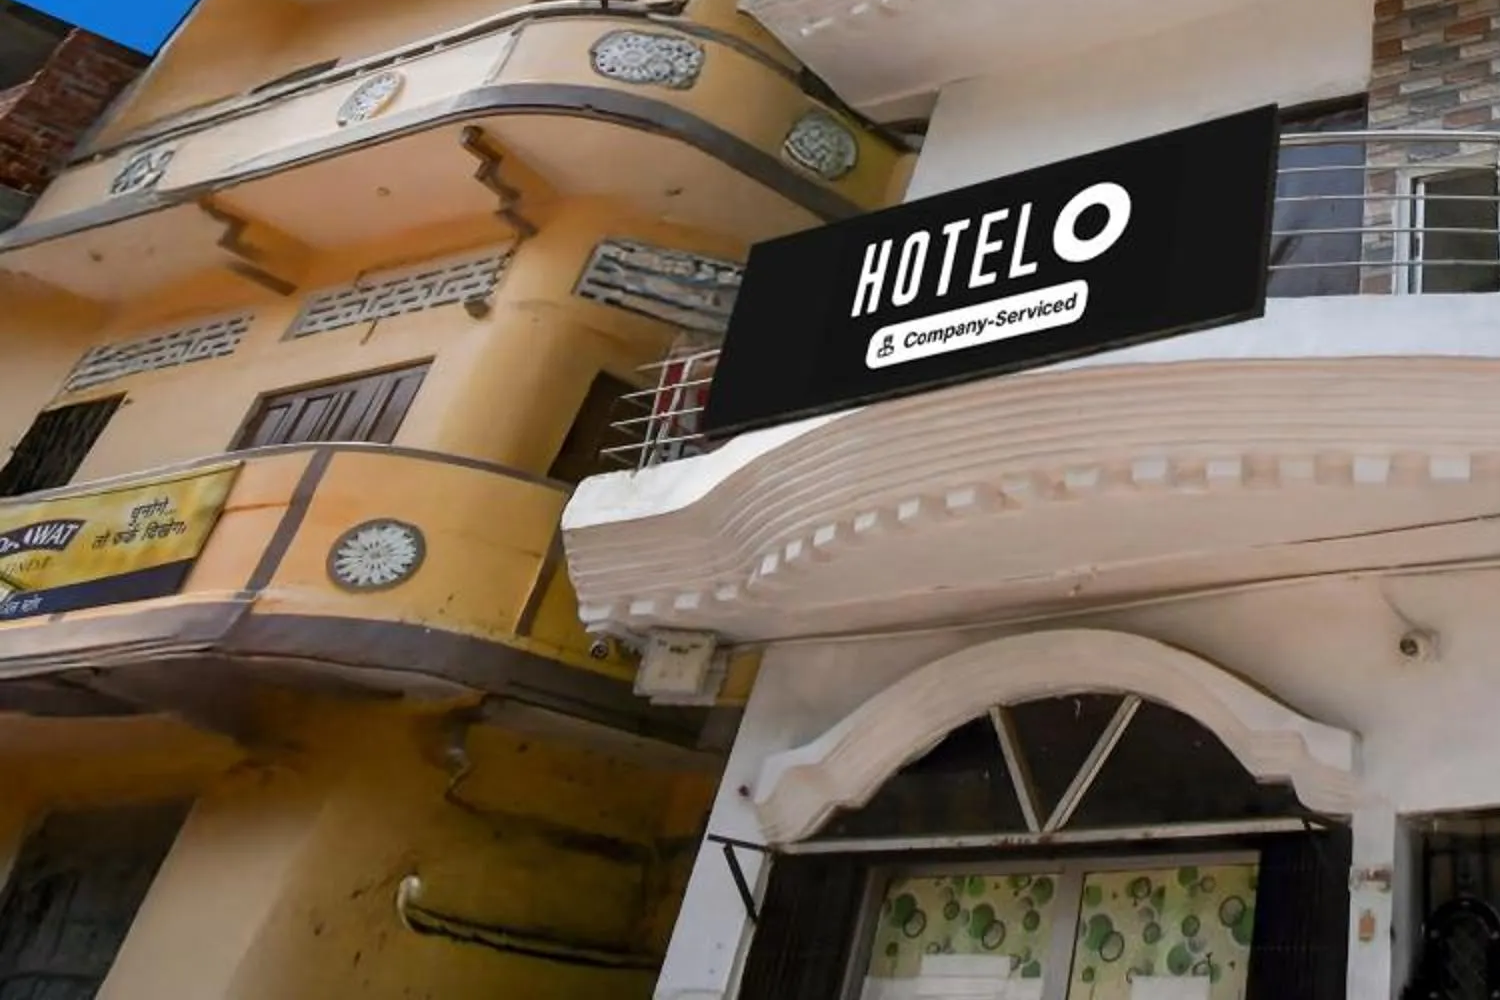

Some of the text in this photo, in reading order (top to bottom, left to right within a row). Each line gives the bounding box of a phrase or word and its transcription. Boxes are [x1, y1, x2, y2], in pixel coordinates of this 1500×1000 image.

[851, 182, 1131, 317] HOTEL O
[903, 292, 1077, 349] Company-Serviced
